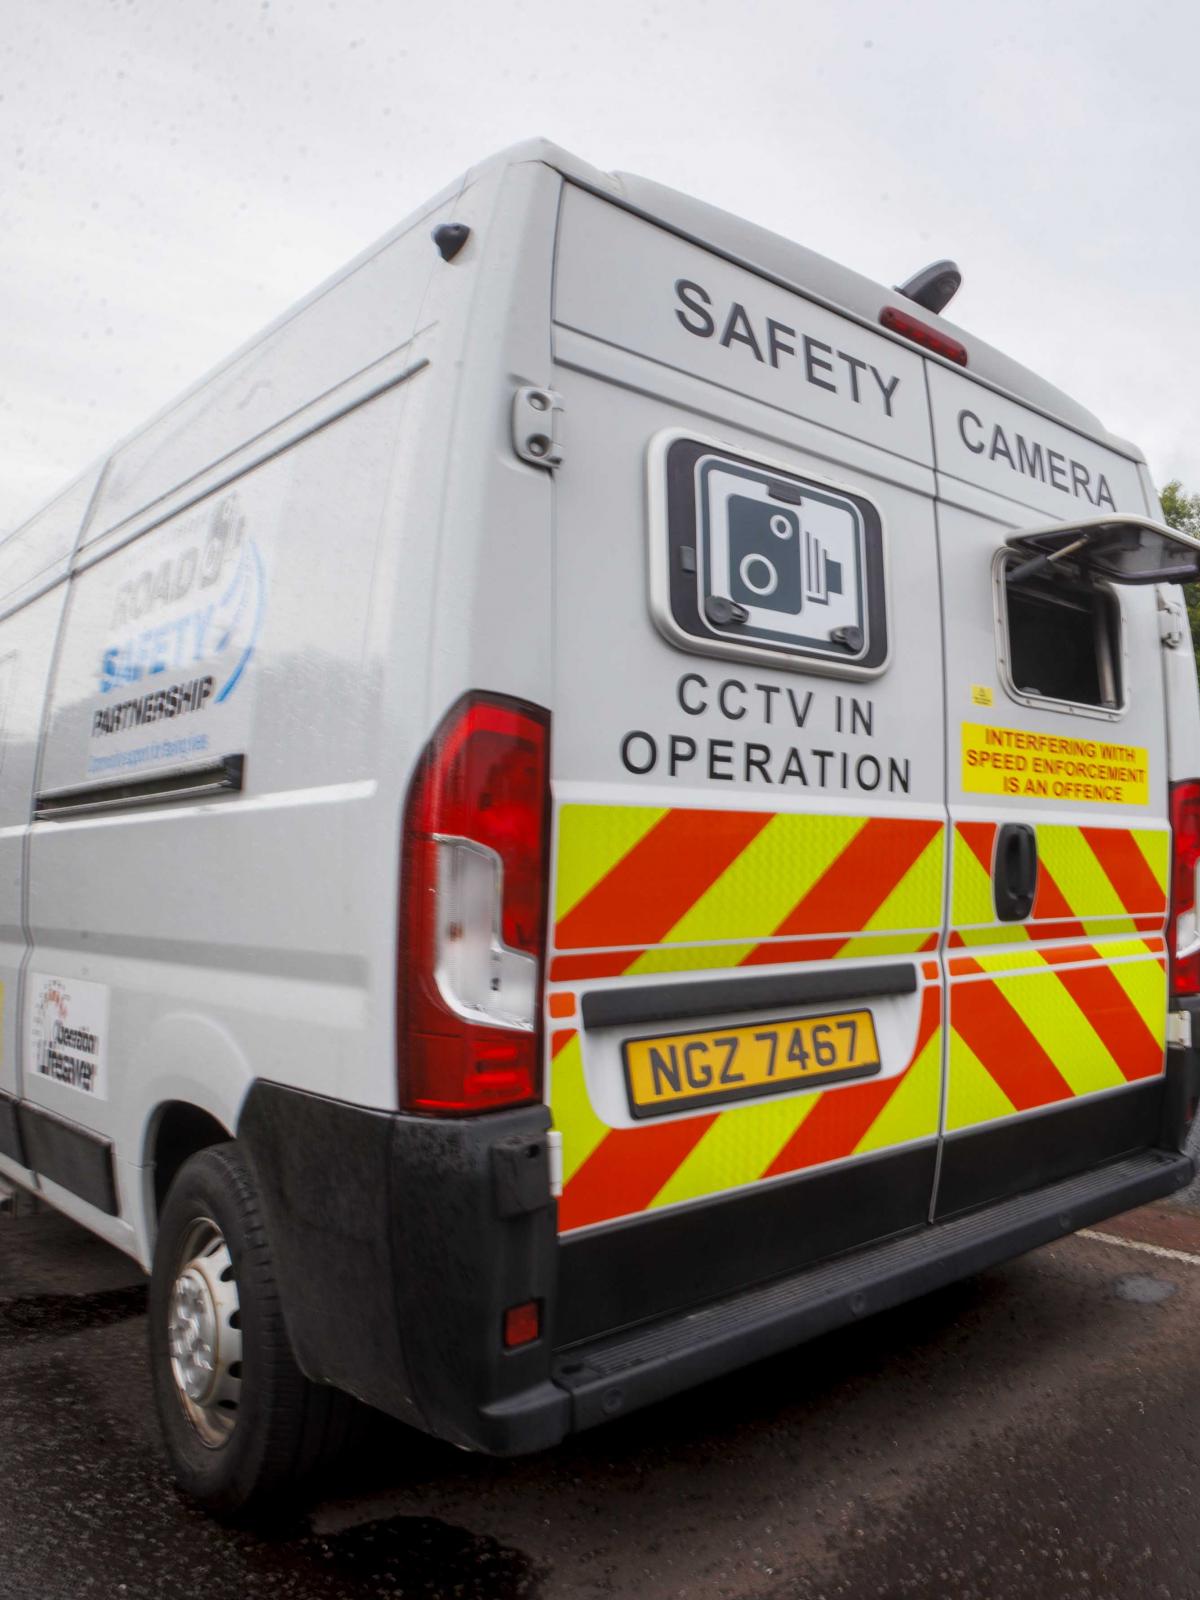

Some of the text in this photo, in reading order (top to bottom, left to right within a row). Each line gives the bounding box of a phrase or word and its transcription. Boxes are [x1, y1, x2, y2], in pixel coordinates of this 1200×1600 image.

[674, 279, 1116, 512] SAFETY CAMERA
[91, 675, 216, 737] PARTNERSHIP
[676, 673, 873, 736] CCTV IN
[620, 730, 911, 793] OPERATION
[967, 749, 1144, 783] SPEED ENFORCEMENT
[986, 728, 1135, 762] INTERFERING WITH
[1003, 776, 1123, 801] IS AN OFFENCE
[648, 1020, 857, 1095] NGZ 7467
